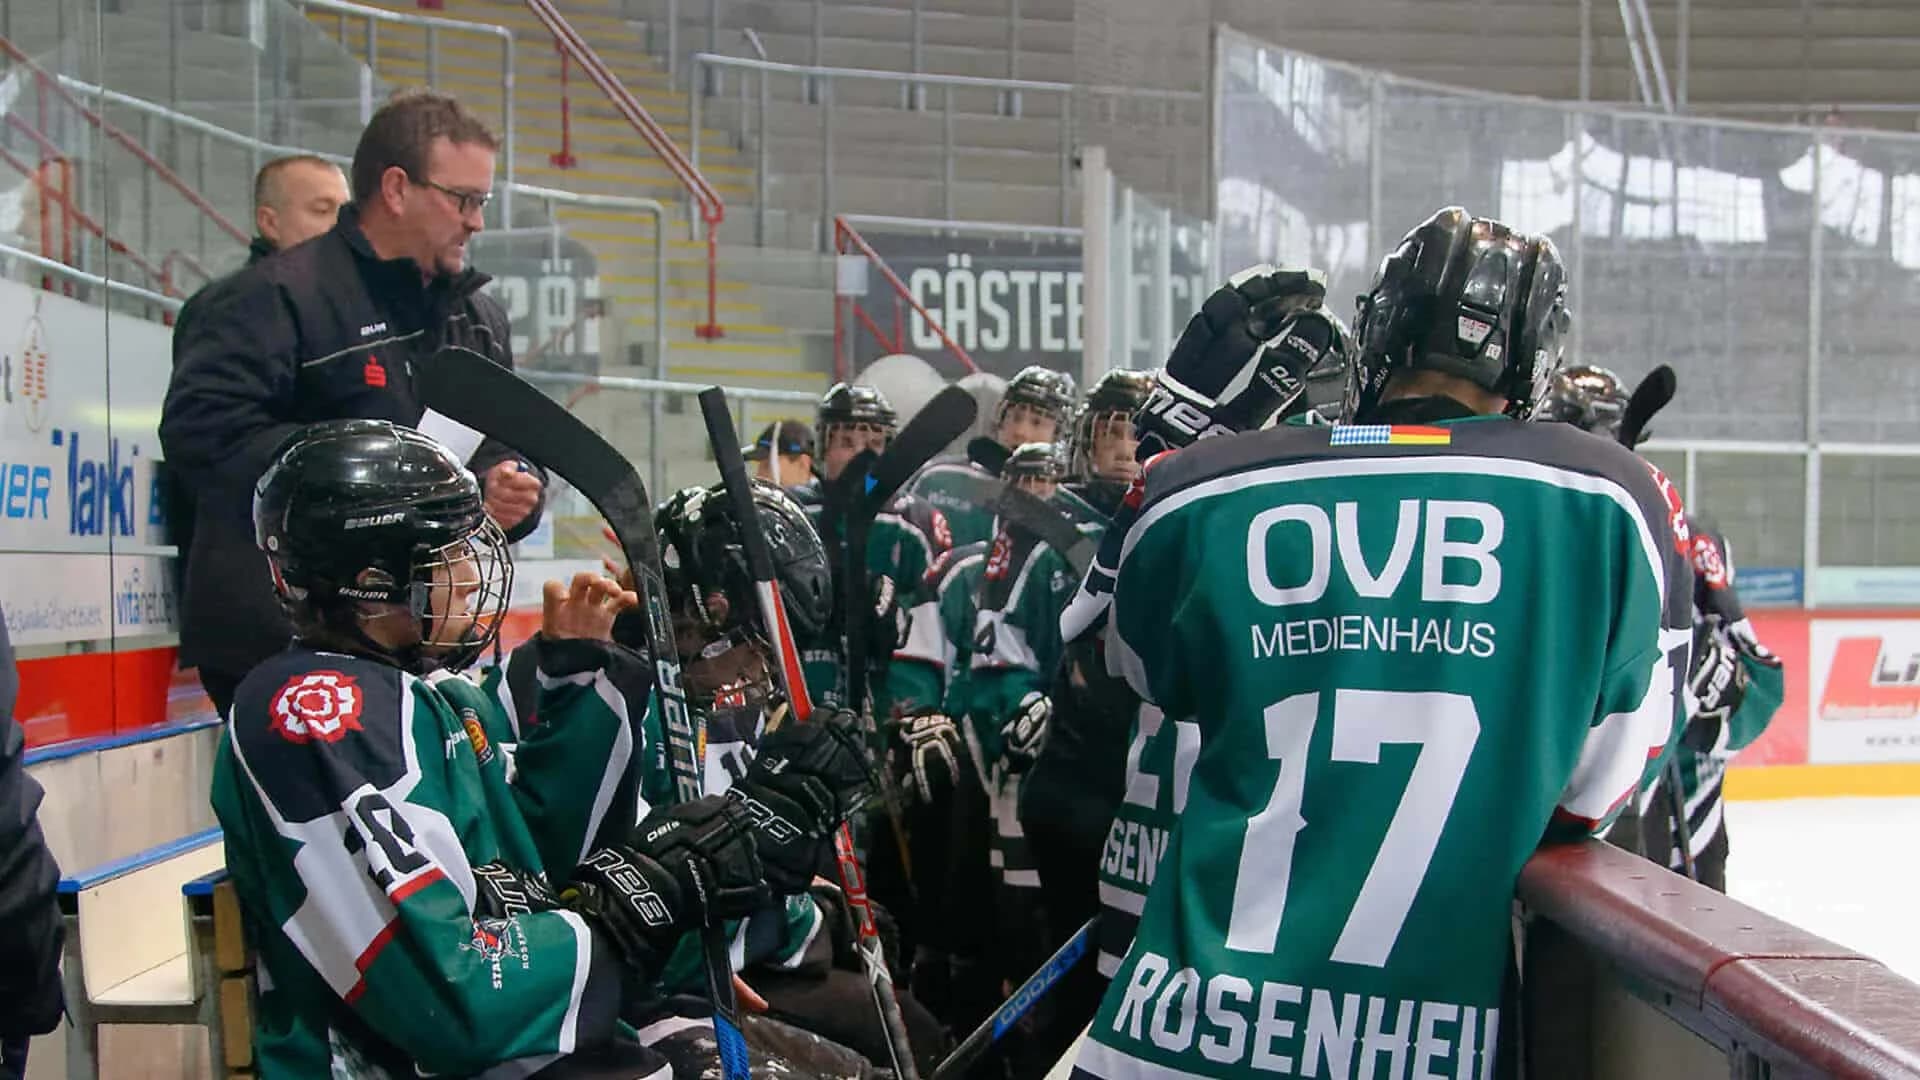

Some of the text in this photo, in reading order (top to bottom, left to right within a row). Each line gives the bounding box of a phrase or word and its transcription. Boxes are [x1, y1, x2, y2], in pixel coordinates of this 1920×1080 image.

[1246, 499, 1505, 607] OVB
[1251, 615, 1497, 660] MEDIENHAUS
[1224, 688, 1482, 968] 17
